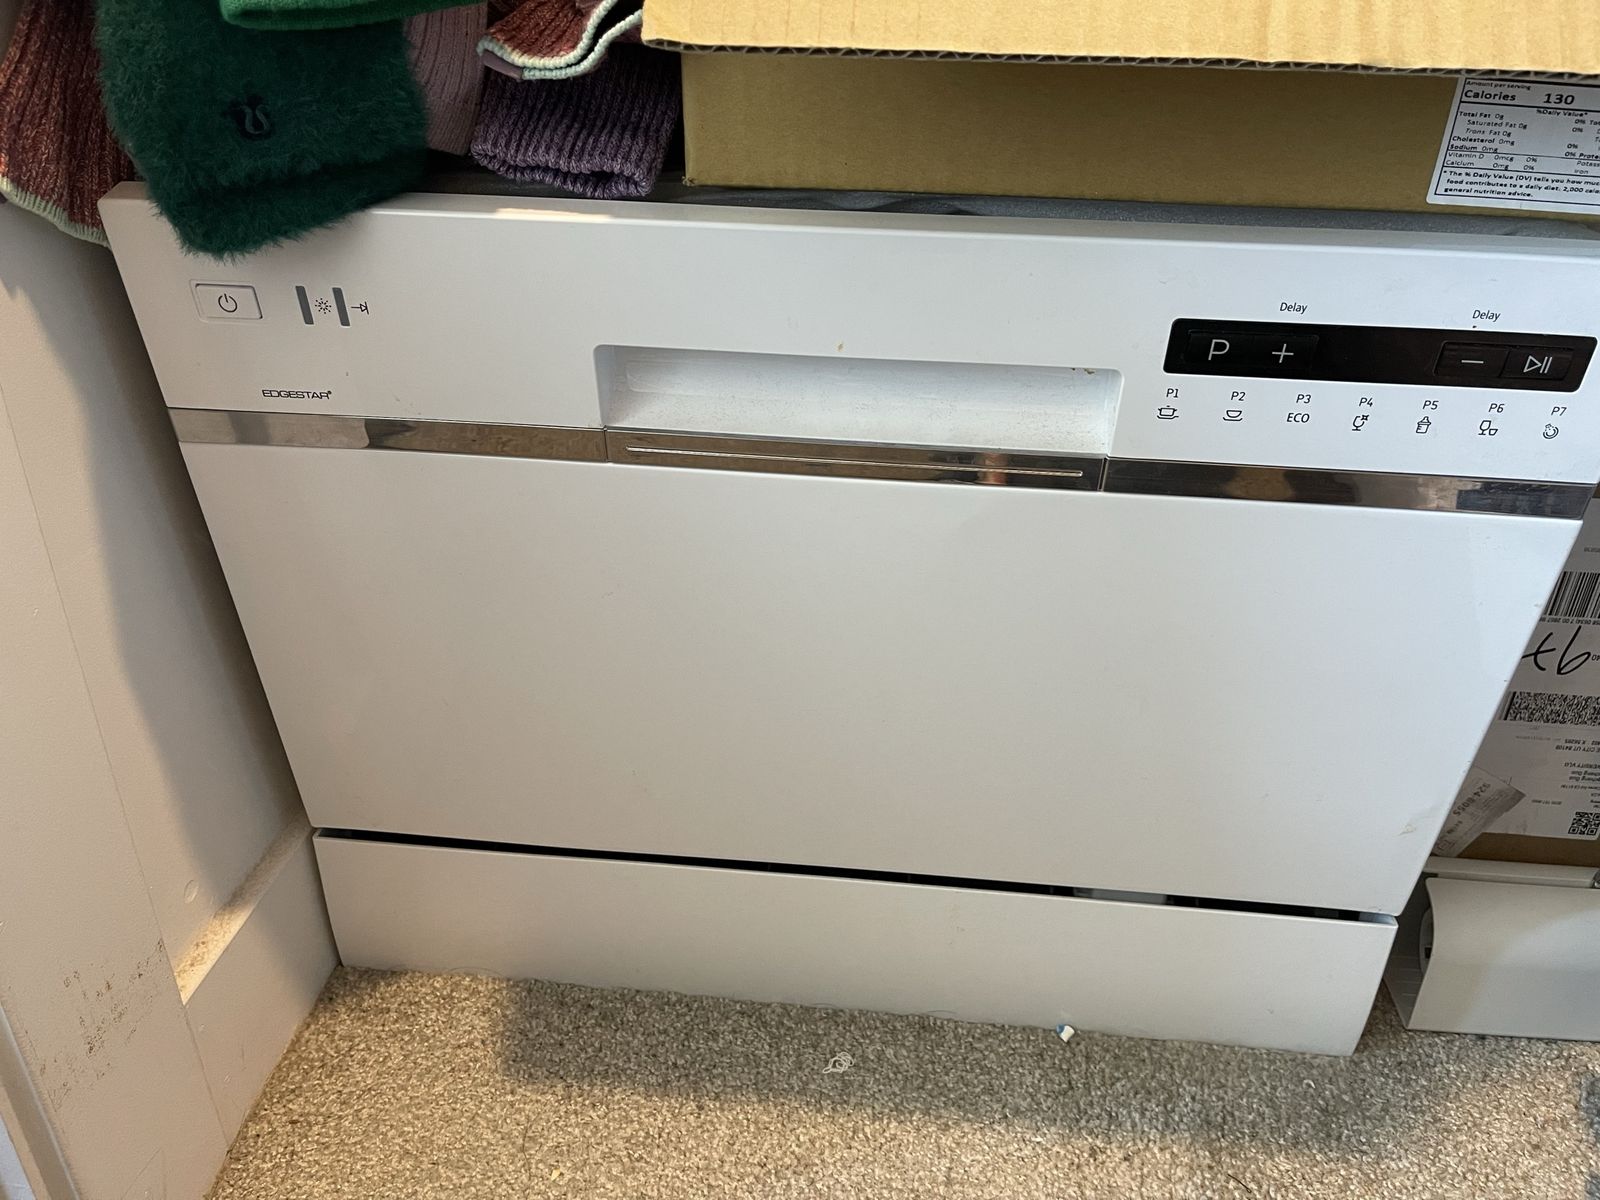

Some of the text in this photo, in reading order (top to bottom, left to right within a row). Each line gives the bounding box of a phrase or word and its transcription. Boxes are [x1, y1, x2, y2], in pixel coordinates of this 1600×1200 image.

[1464, 90, 1575, 105] Calories 130
[1467, 119, 1503, 128] Saturated
[1466, 127, 1485, 135] Trans
[1452, 135, 1495, 143] Cholesterol
[1472, 171, 1492, 179] Daily
[1465, 180, 1508, 188] contributes
[1279, 302, 1308, 314] Delay
[1472, 309, 1501, 322] Delay
[1208, 339, 1230, 361] P
[1166, 388, 1179, 399] P1
[1230, 391, 1246, 402] P2
[1296, 394, 1311, 405] P3
[1358, 397, 1374, 408] P4
[1422, 400, 1439, 411] P5
[1488, 403, 1505, 414] P6
[1551, 406, 1567, 417] P7
[1287, 412, 1310, 424] ECO
